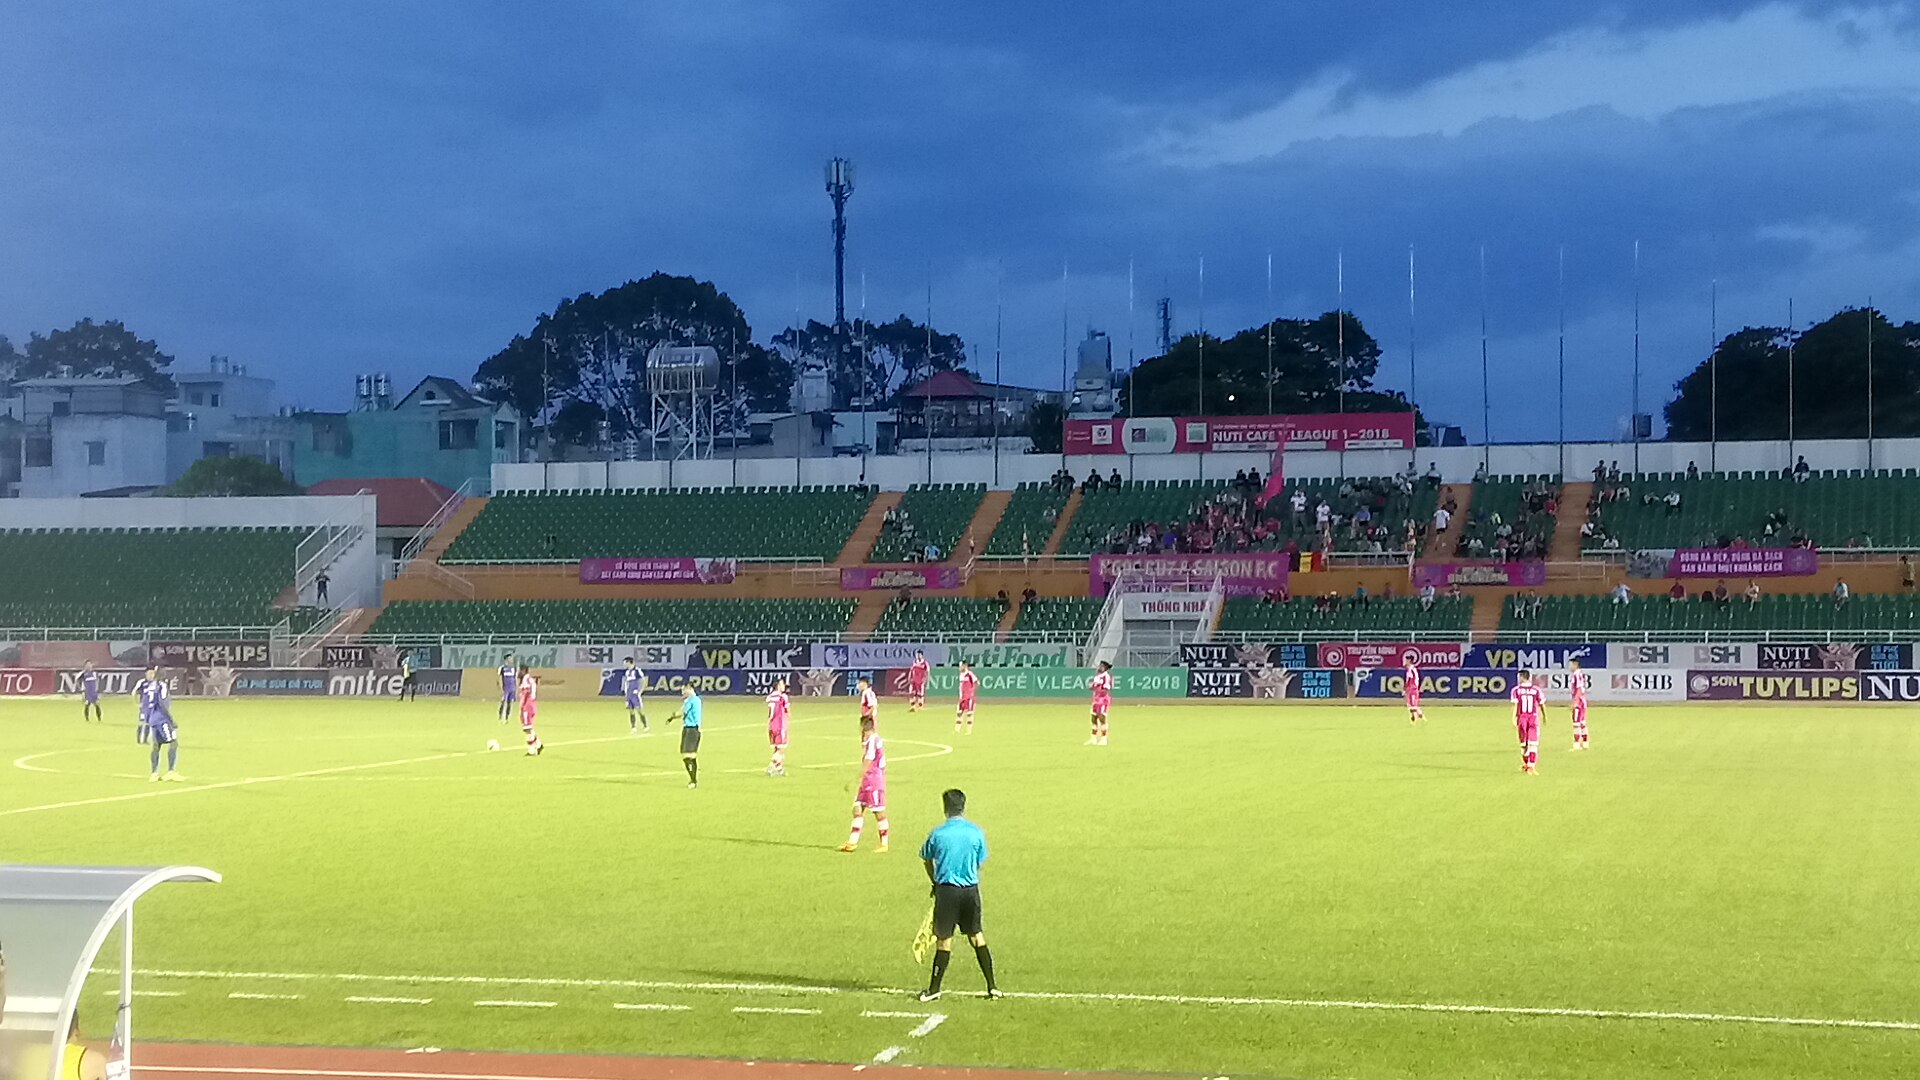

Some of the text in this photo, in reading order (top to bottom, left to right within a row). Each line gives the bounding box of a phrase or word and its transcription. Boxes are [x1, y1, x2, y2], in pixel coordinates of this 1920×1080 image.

[1213, 430, 1242, 442] NUTI
[327, 648, 363, 660] NUTI
[947, 645, 1067, 667] NutiFood
[1184, 646, 1228, 660] NUTI
[1764, 647, 1810, 660] NUTI
[57, 672, 130, 693] NTI
[329, 670, 404, 695] mitre
[689, 675, 731, 692] PRO
[747, 672, 791, 686] NUTI
[982, 672, 1027, 689] CAFÉ
[1037, 675, 1122, 690] V.LEAE
[1127, 675, 1180, 690] 1-2018
[1193, 673, 1241, 686] NUTI
[1381, 676, 1506, 694] IQAC PRO
[1631, 674, 1673, 690] SHB
[1740, 676, 1858, 698] TUYLIPS
